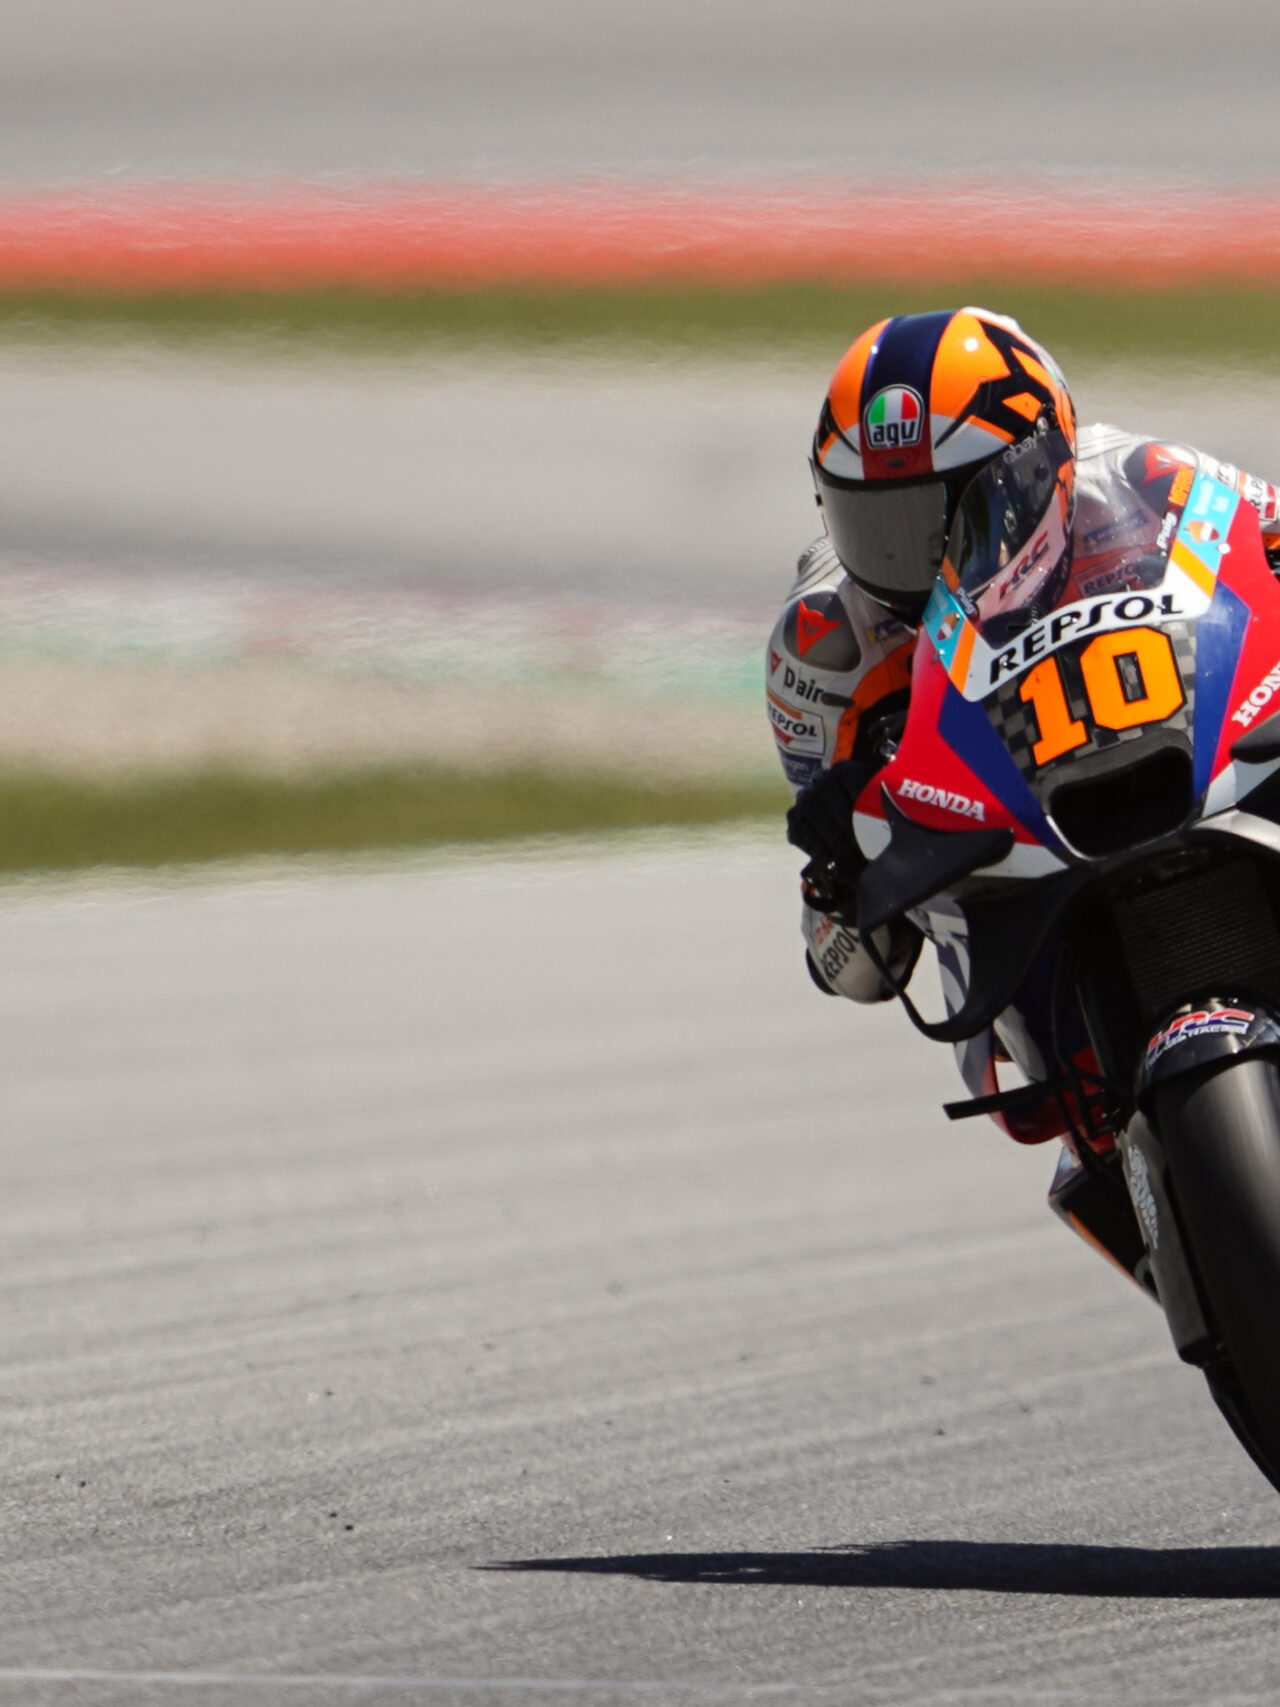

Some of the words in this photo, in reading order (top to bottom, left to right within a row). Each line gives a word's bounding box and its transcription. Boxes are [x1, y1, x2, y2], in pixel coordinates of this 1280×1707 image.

[873, 421, 916, 446] agv
[990, 594, 1184, 685] REPSOL
[1018, 626, 1185, 768] 10
[897, 777, 986, 823] HONDA
